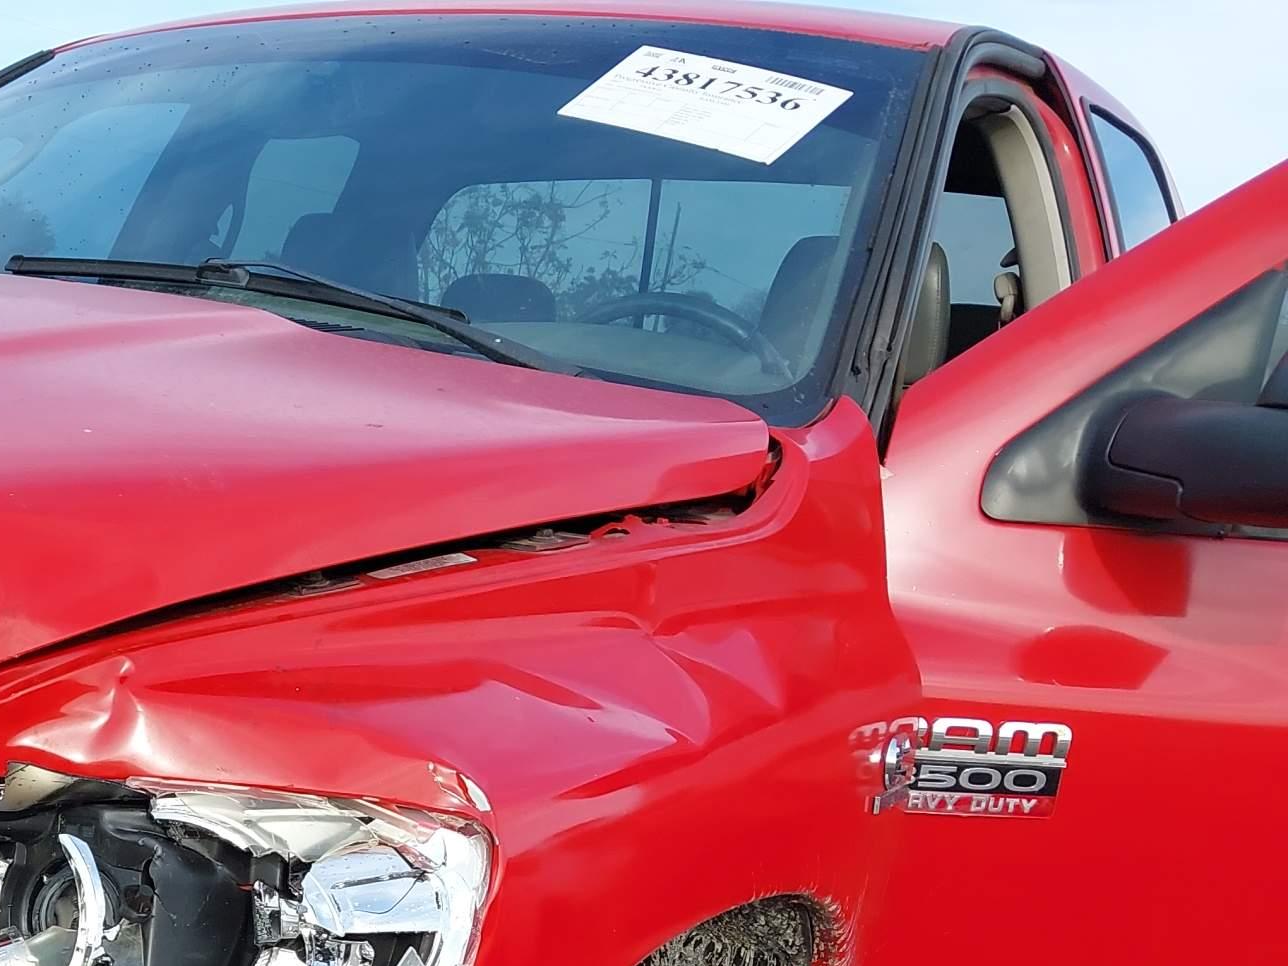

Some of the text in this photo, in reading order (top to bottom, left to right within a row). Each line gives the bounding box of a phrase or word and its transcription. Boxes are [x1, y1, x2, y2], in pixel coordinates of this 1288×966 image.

[635, 65, 806, 111] 43817536
[911, 764, 1047, 793] 500
[970, 796, 1038, 814] DUTY
